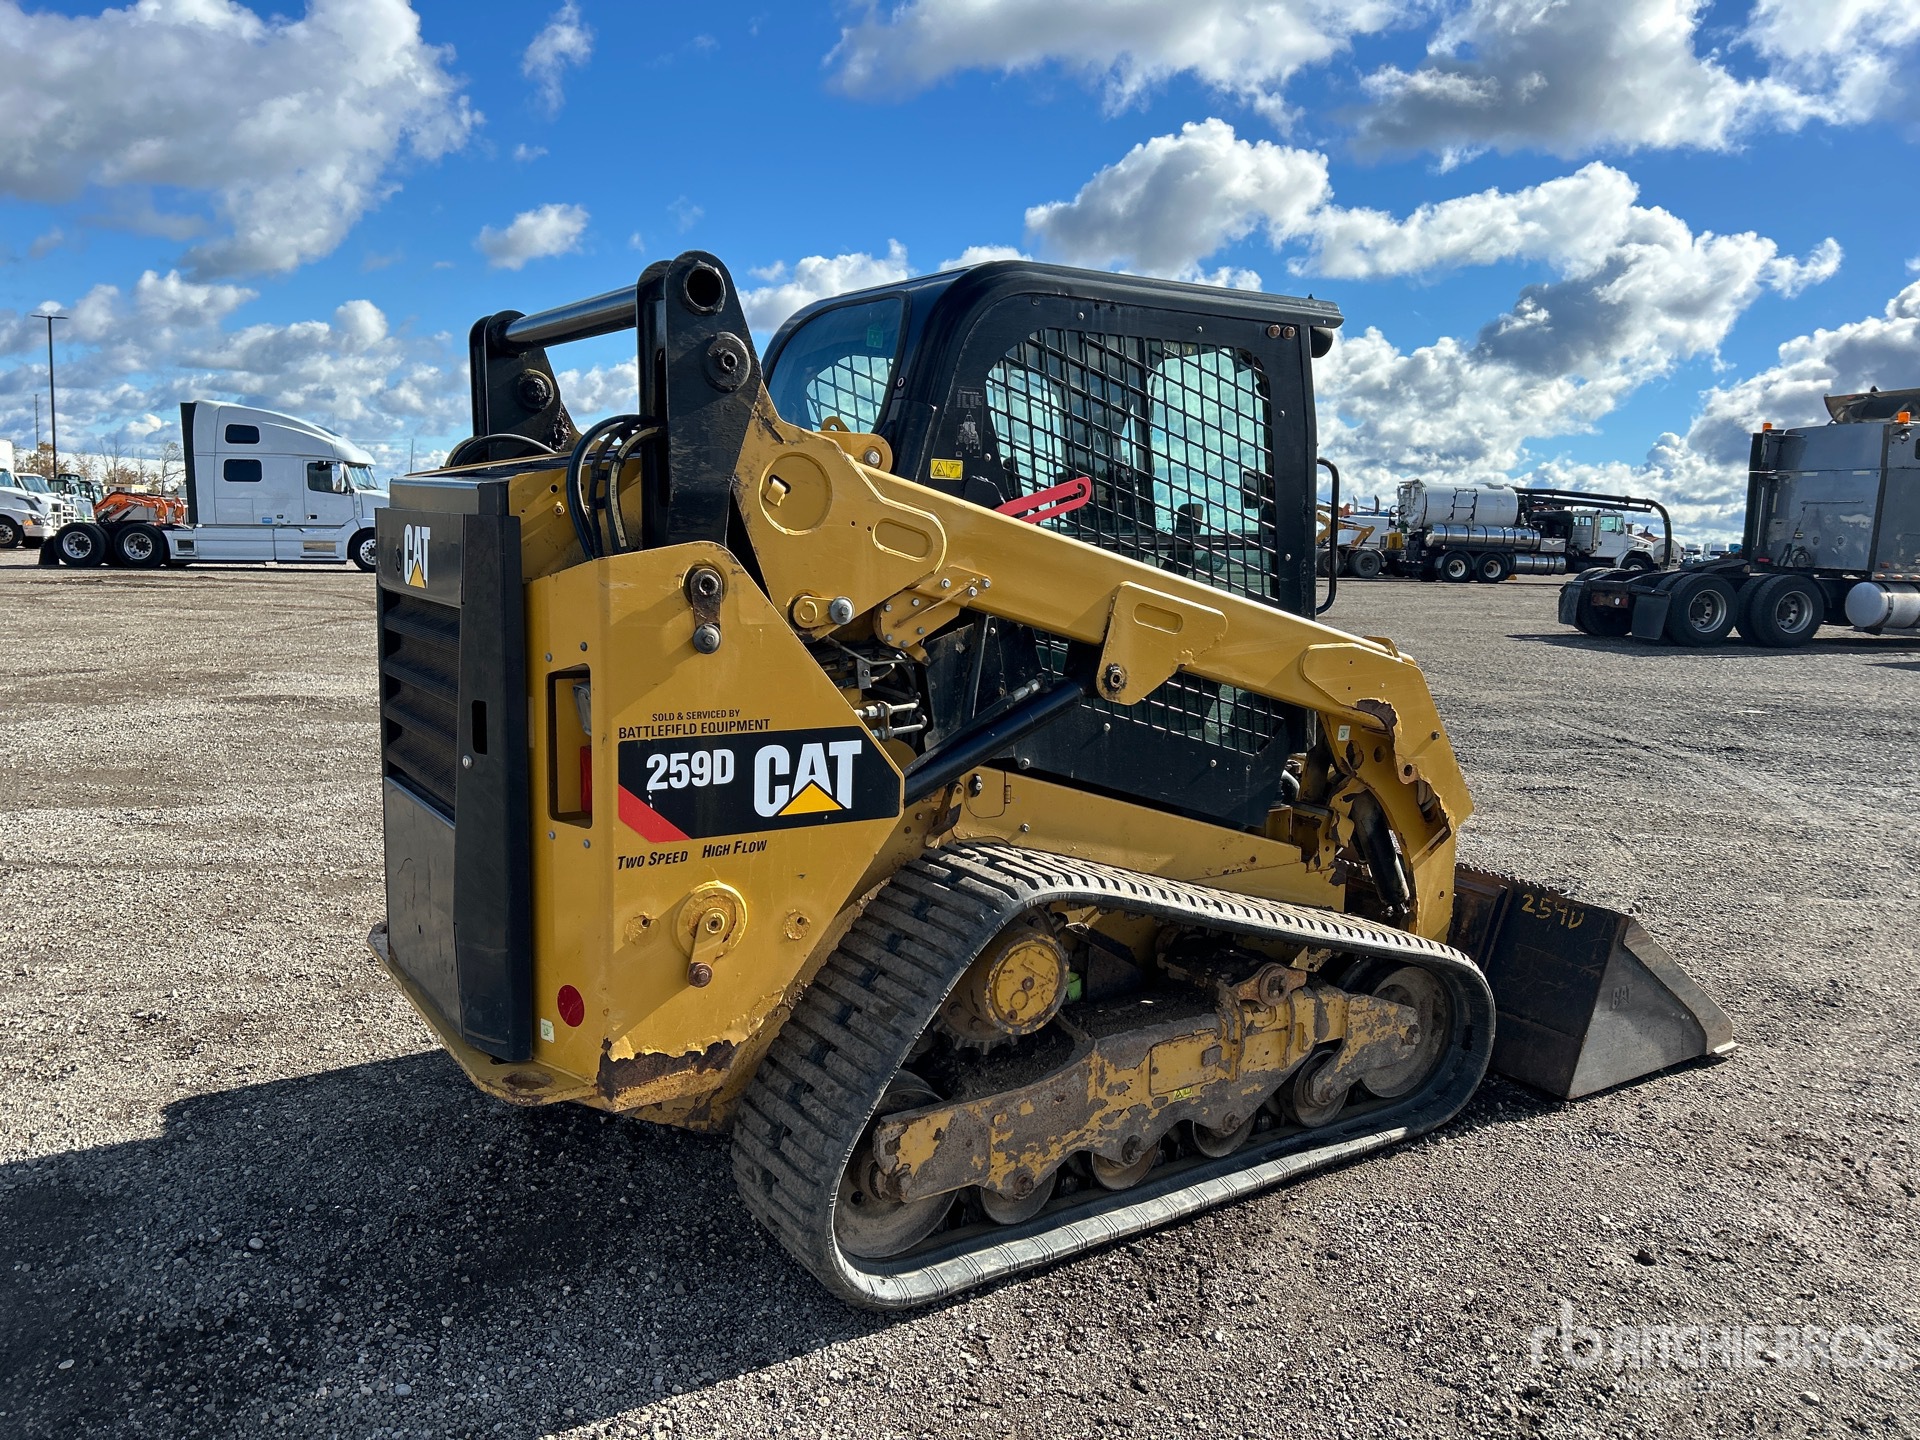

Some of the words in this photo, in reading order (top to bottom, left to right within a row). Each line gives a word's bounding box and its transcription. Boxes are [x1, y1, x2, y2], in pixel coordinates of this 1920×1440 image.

[404, 524, 430, 588] CAT
[652, 713, 675, 722] SOLD
[676, 712, 684, 720] &
[686, 710, 727, 720] SERVICED
[729, 709, 740, 718] BY
[701, 719, 770, 734] EQUIPMENT
[646, 749, 735, 791] 259D
[754, 740, 862, 818] CAT
